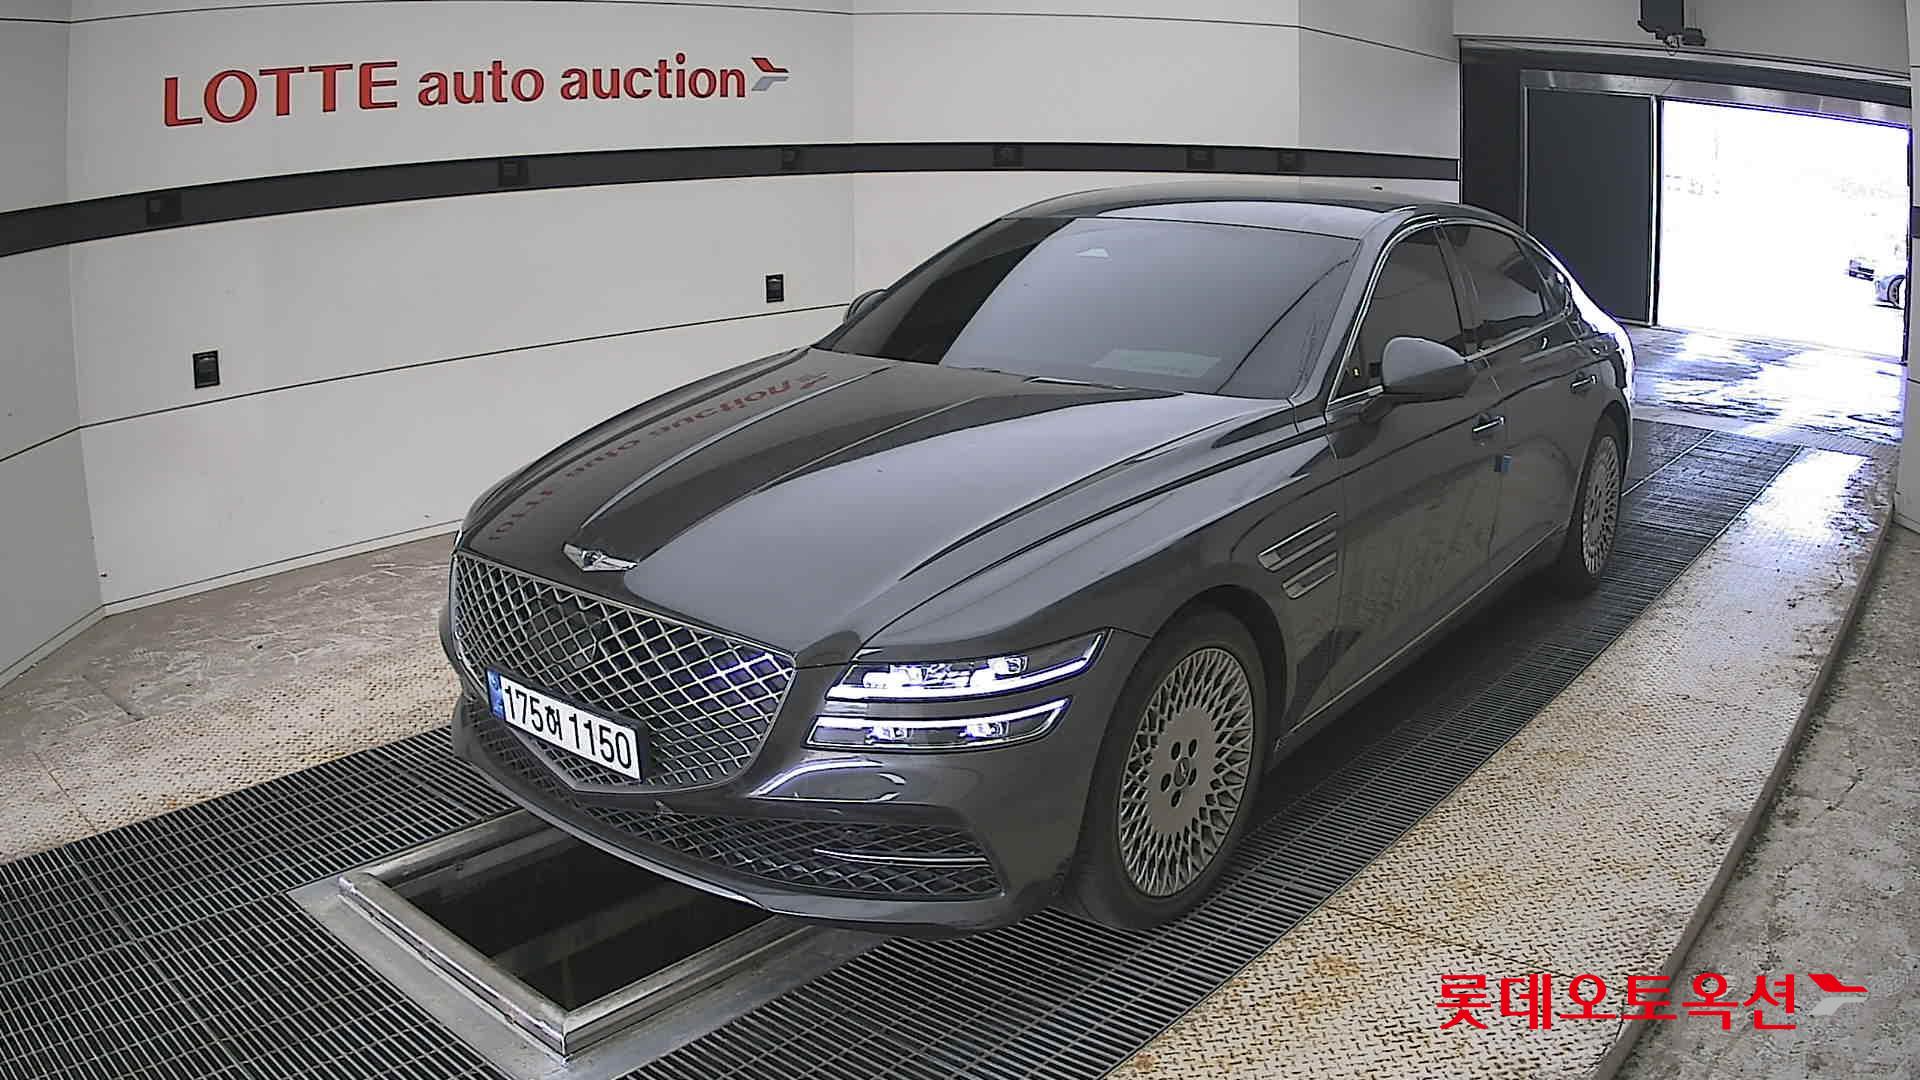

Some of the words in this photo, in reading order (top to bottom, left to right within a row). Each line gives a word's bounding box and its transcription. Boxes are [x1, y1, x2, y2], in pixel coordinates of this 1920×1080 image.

[163, 60, 398, 127] LOTTE
[417, 60, 545, 106] auto
[560, 53, 747, 100] auction
[504, 685, 563, 741] 175허
[568, 713, 632, 769] 1150
